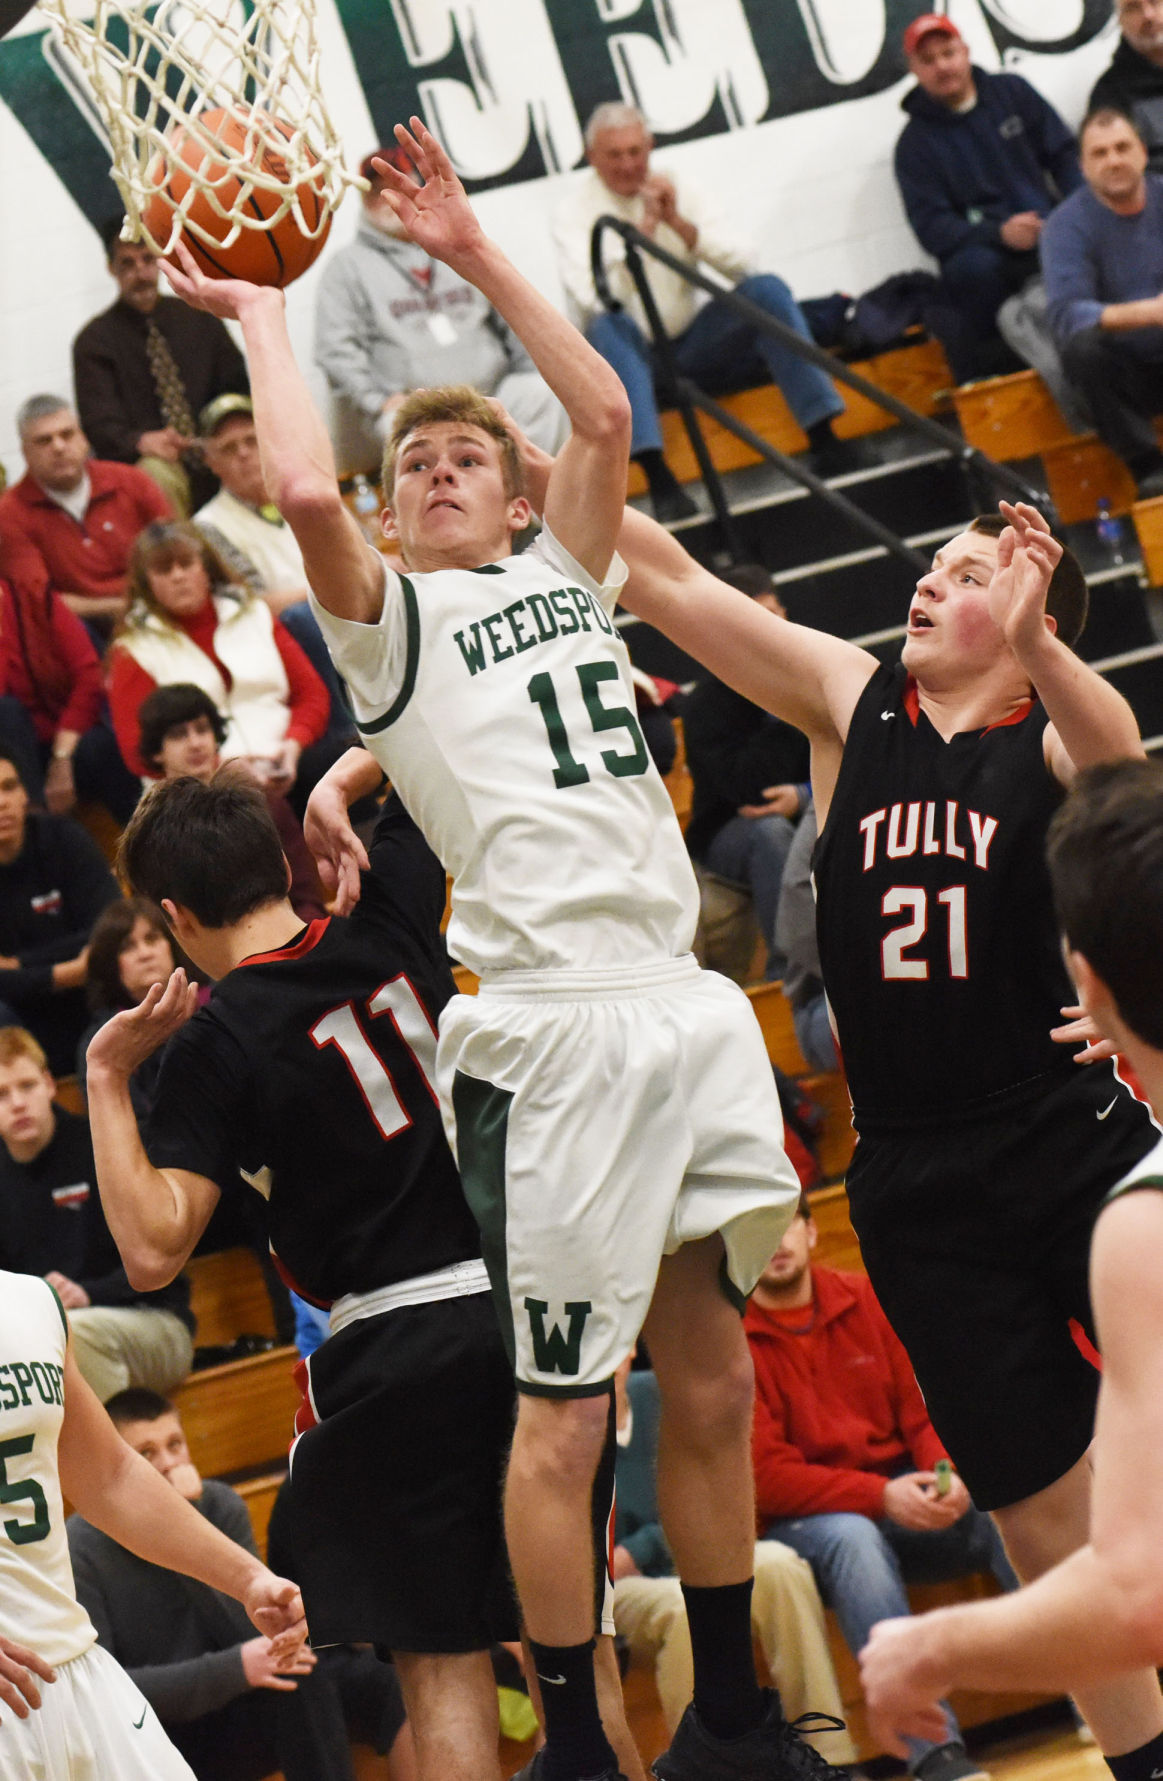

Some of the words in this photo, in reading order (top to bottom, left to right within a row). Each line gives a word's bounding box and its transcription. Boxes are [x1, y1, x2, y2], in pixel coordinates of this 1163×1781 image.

[453, 587, 622, 677] WEEDSPO
[527, 660, 650, 790] 15
[858, 800, 1000, 874] TULLY
[881, 883, 969, 982] 21
[306, 971, 441, 1142] 11
[523, 1296, 592, 1376] W
[0, 1361, 64, 1412] SPOR
[0, 1433, 52, 1546] 5
